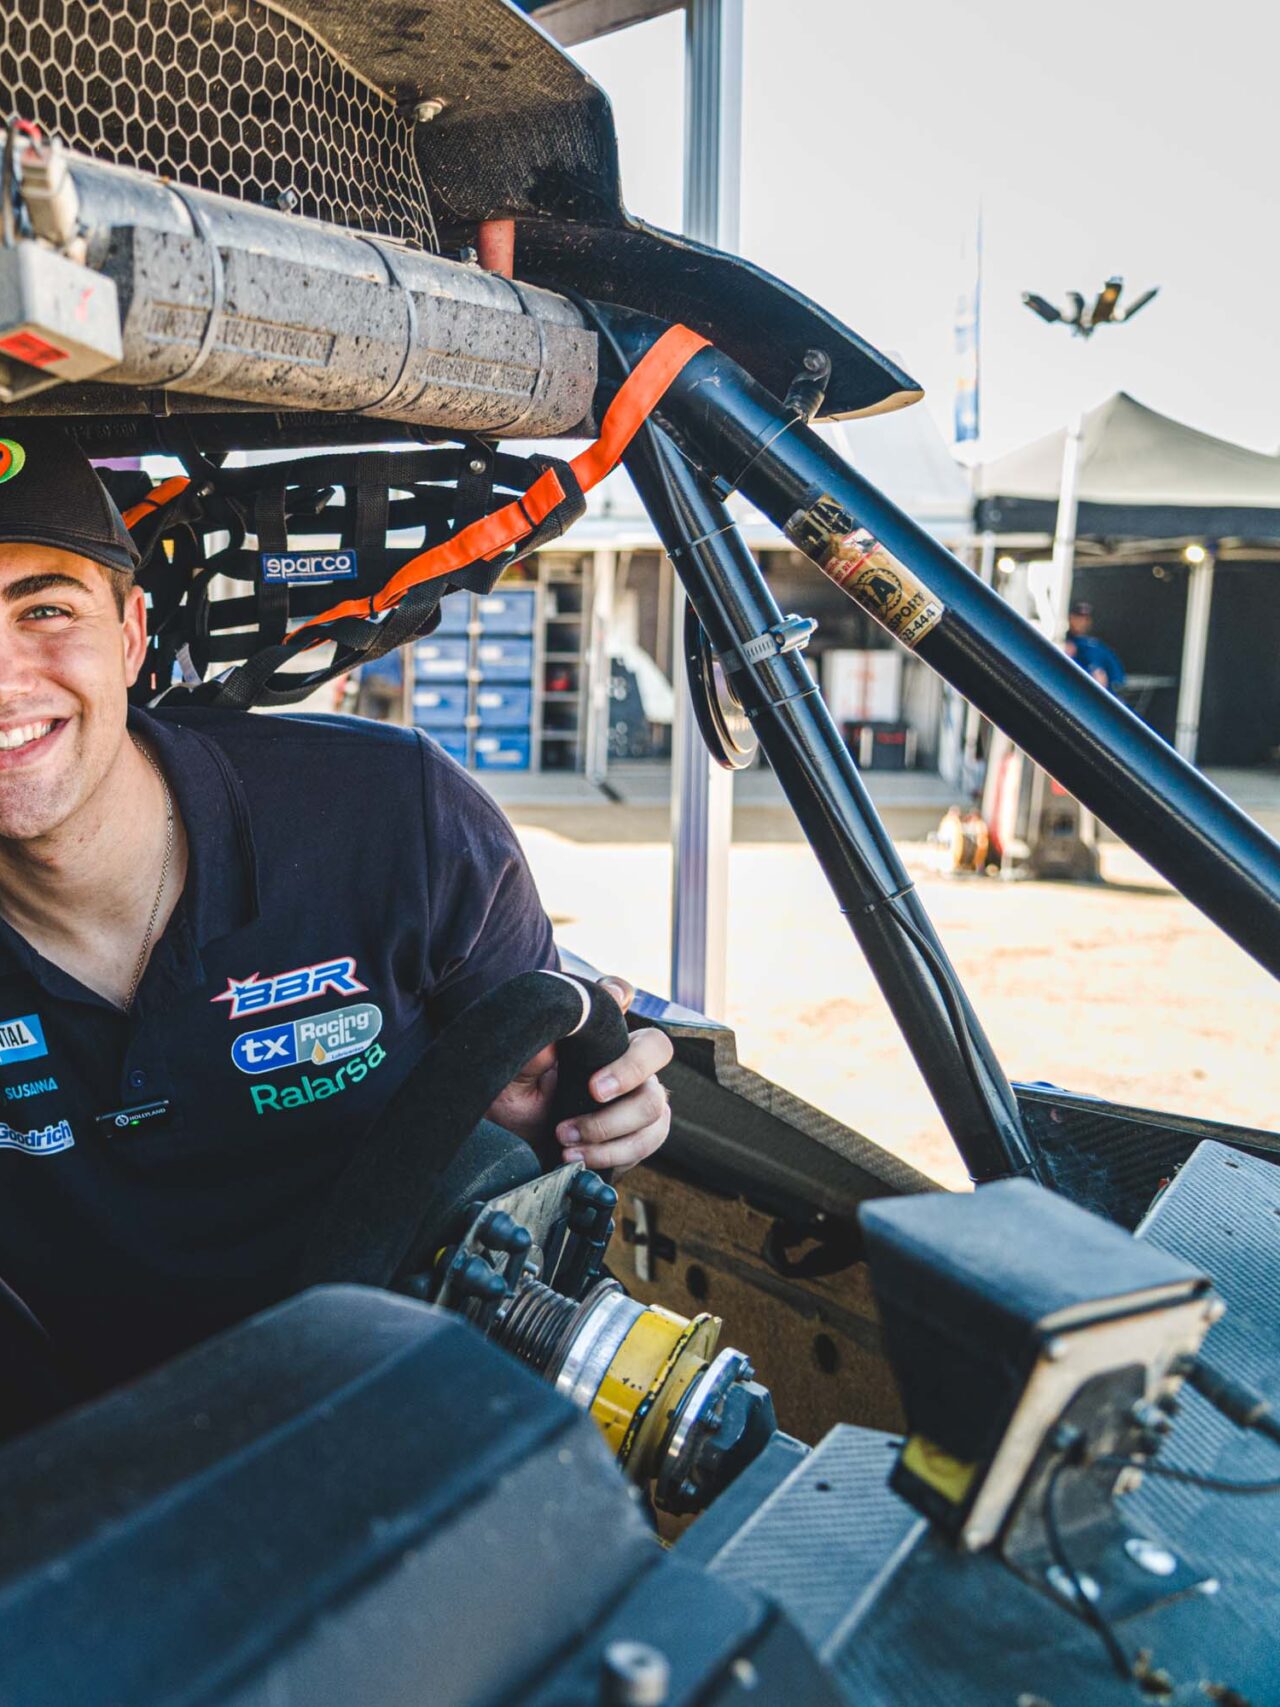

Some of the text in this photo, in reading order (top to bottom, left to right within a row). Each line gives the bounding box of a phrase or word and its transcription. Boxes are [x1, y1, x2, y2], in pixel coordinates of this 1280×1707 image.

[266, 555, 351, 578] sparco
[232, 959, 360, 1014] BBR
[241, 1012, 370, 1064] tx Racing
[250, 1043, 387, 1115] Ralarsa
